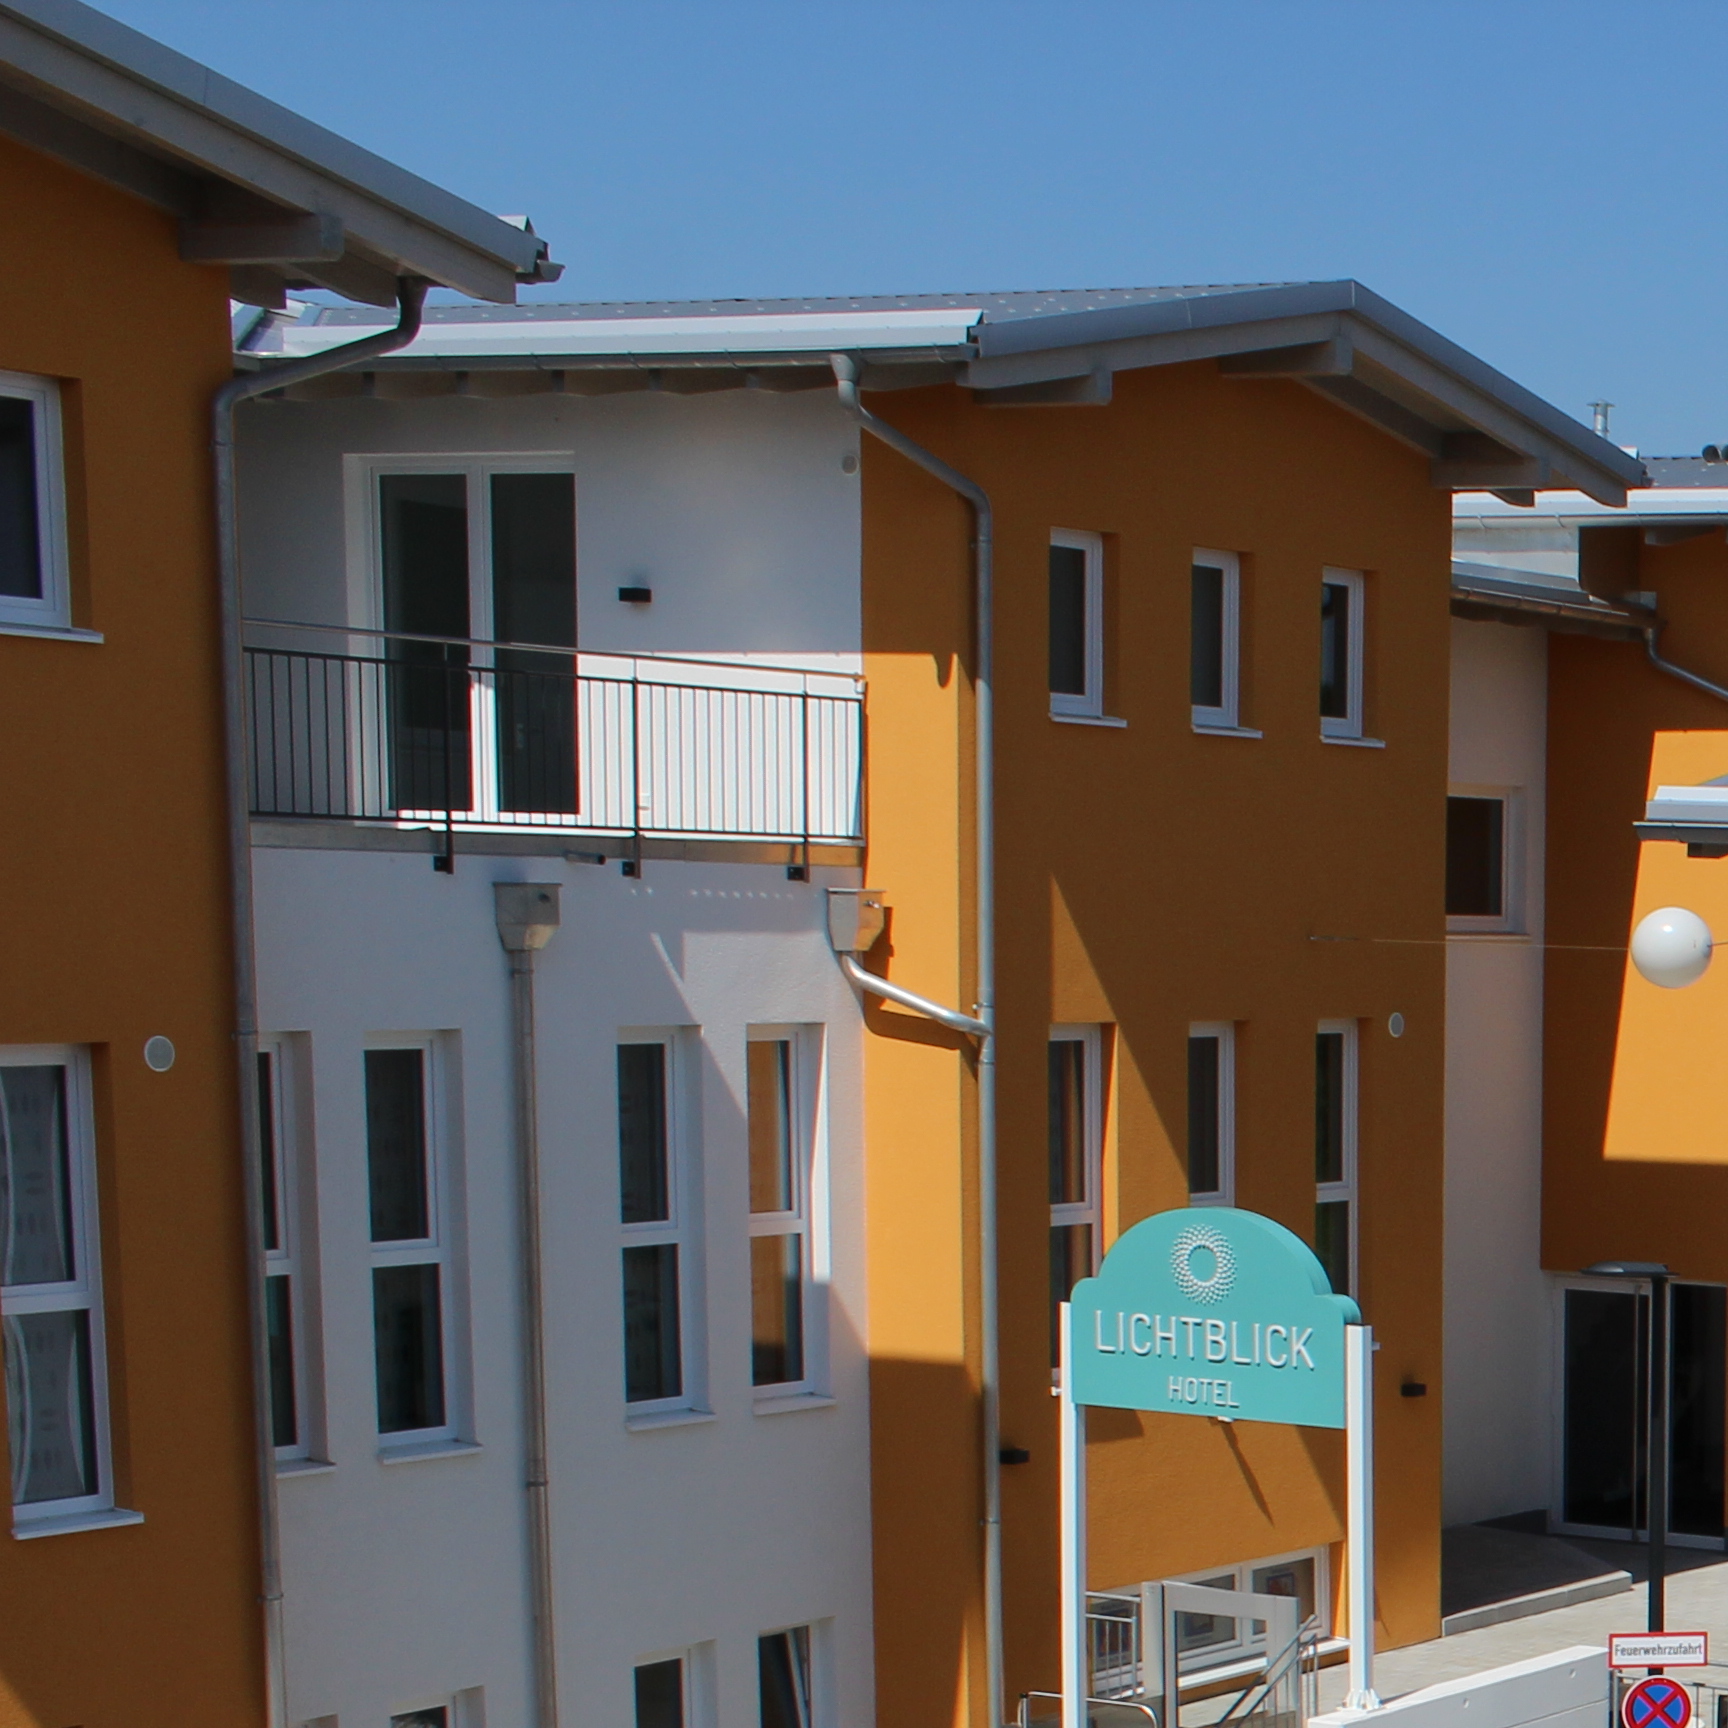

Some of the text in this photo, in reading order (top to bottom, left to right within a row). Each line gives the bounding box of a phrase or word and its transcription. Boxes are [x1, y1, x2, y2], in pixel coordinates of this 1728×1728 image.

[1095, 1310, 1315, 1371] LICHTBLICK
[1168, 1376, 1240, 1408] HOTEL
[1614, 1643, 1702, 1656] Feuerwehrzufahrt
